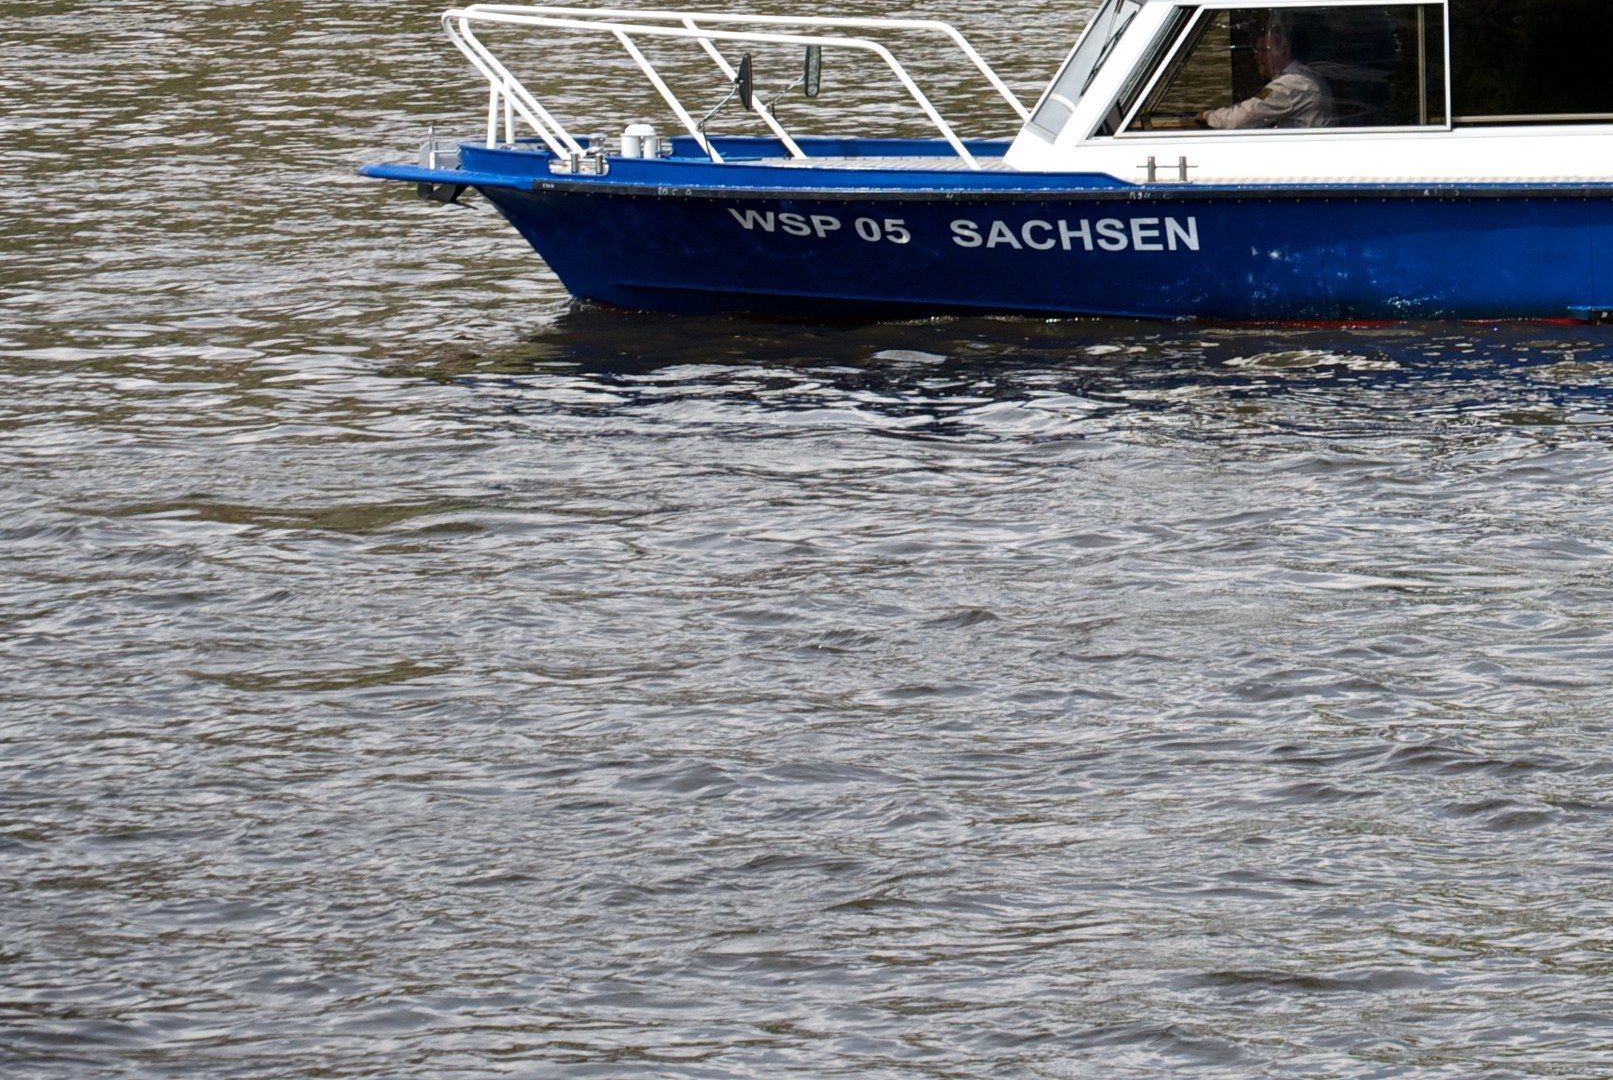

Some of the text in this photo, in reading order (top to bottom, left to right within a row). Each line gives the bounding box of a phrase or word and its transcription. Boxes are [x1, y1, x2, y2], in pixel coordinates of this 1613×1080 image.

[728, 208, 1201, 251] WSP 05 SACHSEN
